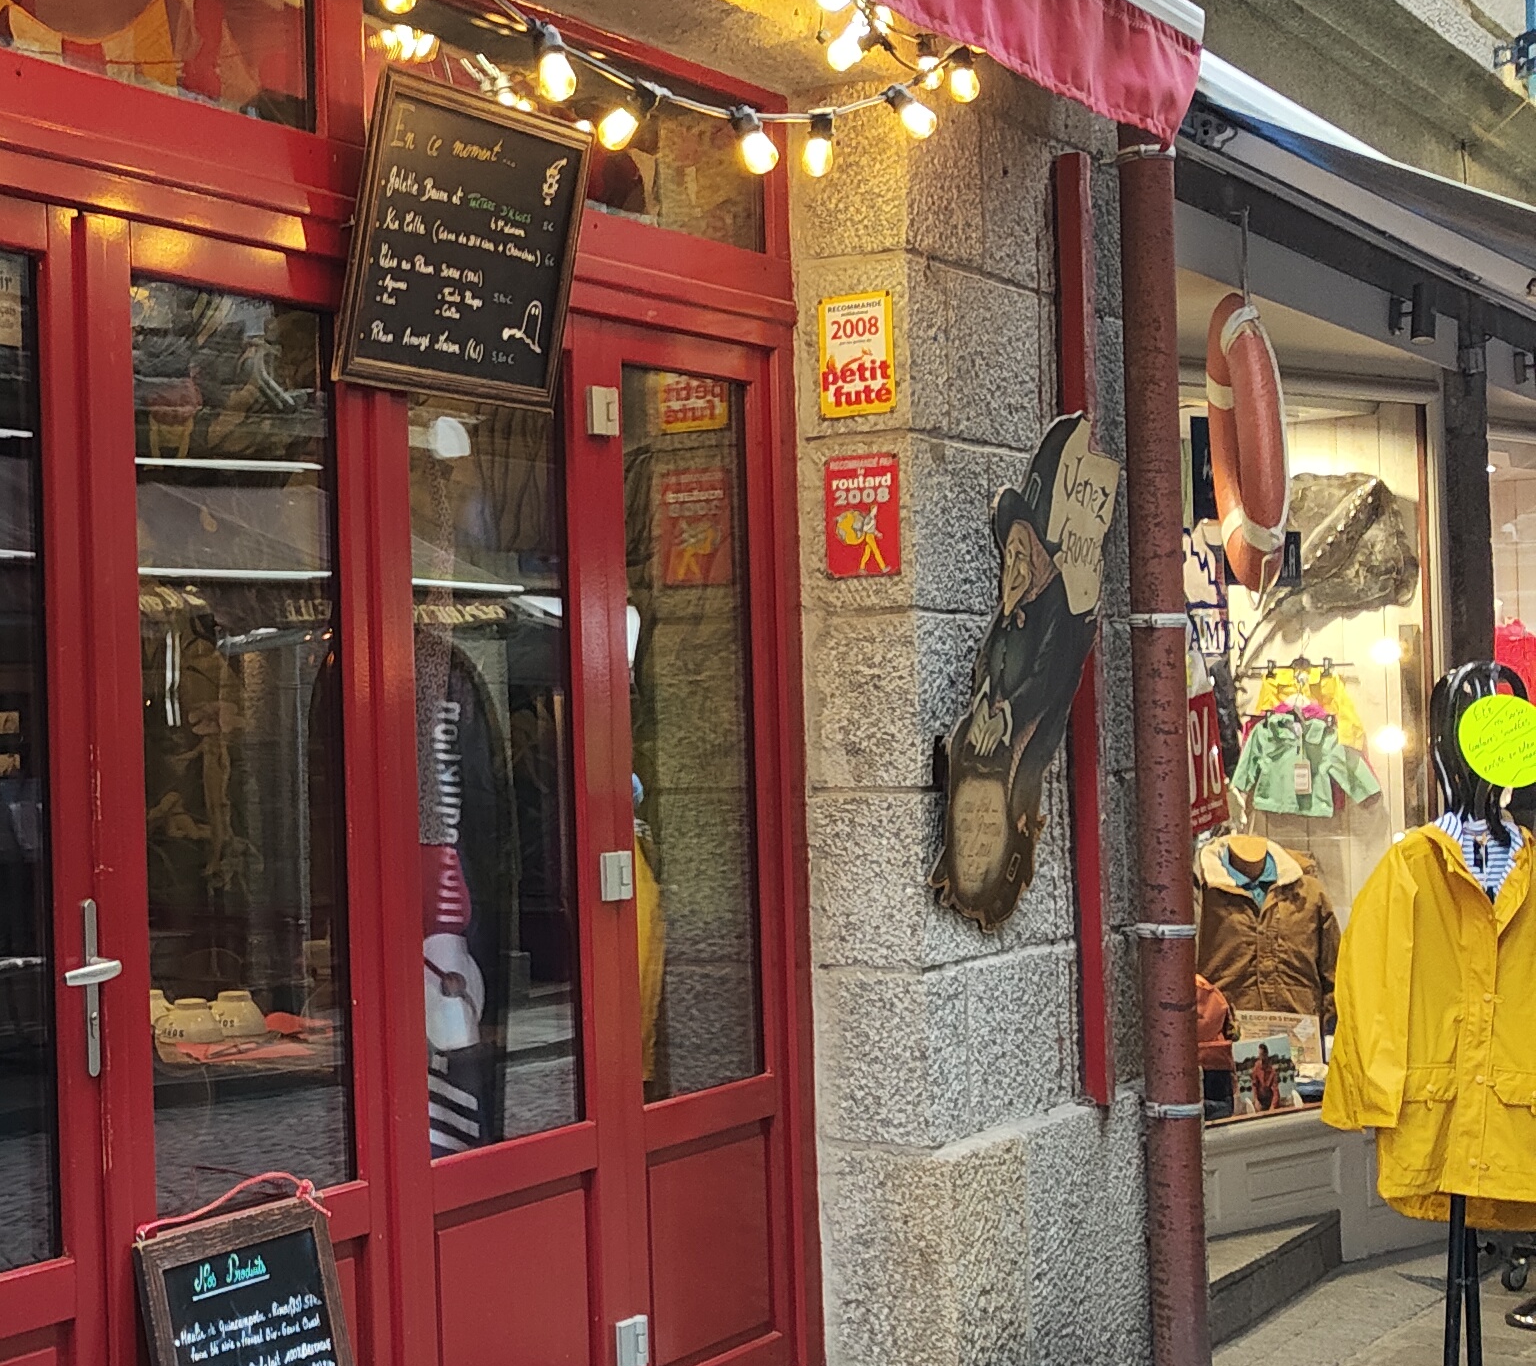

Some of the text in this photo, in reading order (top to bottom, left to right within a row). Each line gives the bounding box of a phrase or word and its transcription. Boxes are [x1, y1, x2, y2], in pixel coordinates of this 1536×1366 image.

[830, 315, 879, 341] 2008
[822, 358, 891, 392] petit
[833, 382, 892, 408] futé
[832, 472, 892, 490] routard
[833, 487, 891, 507] 2008
